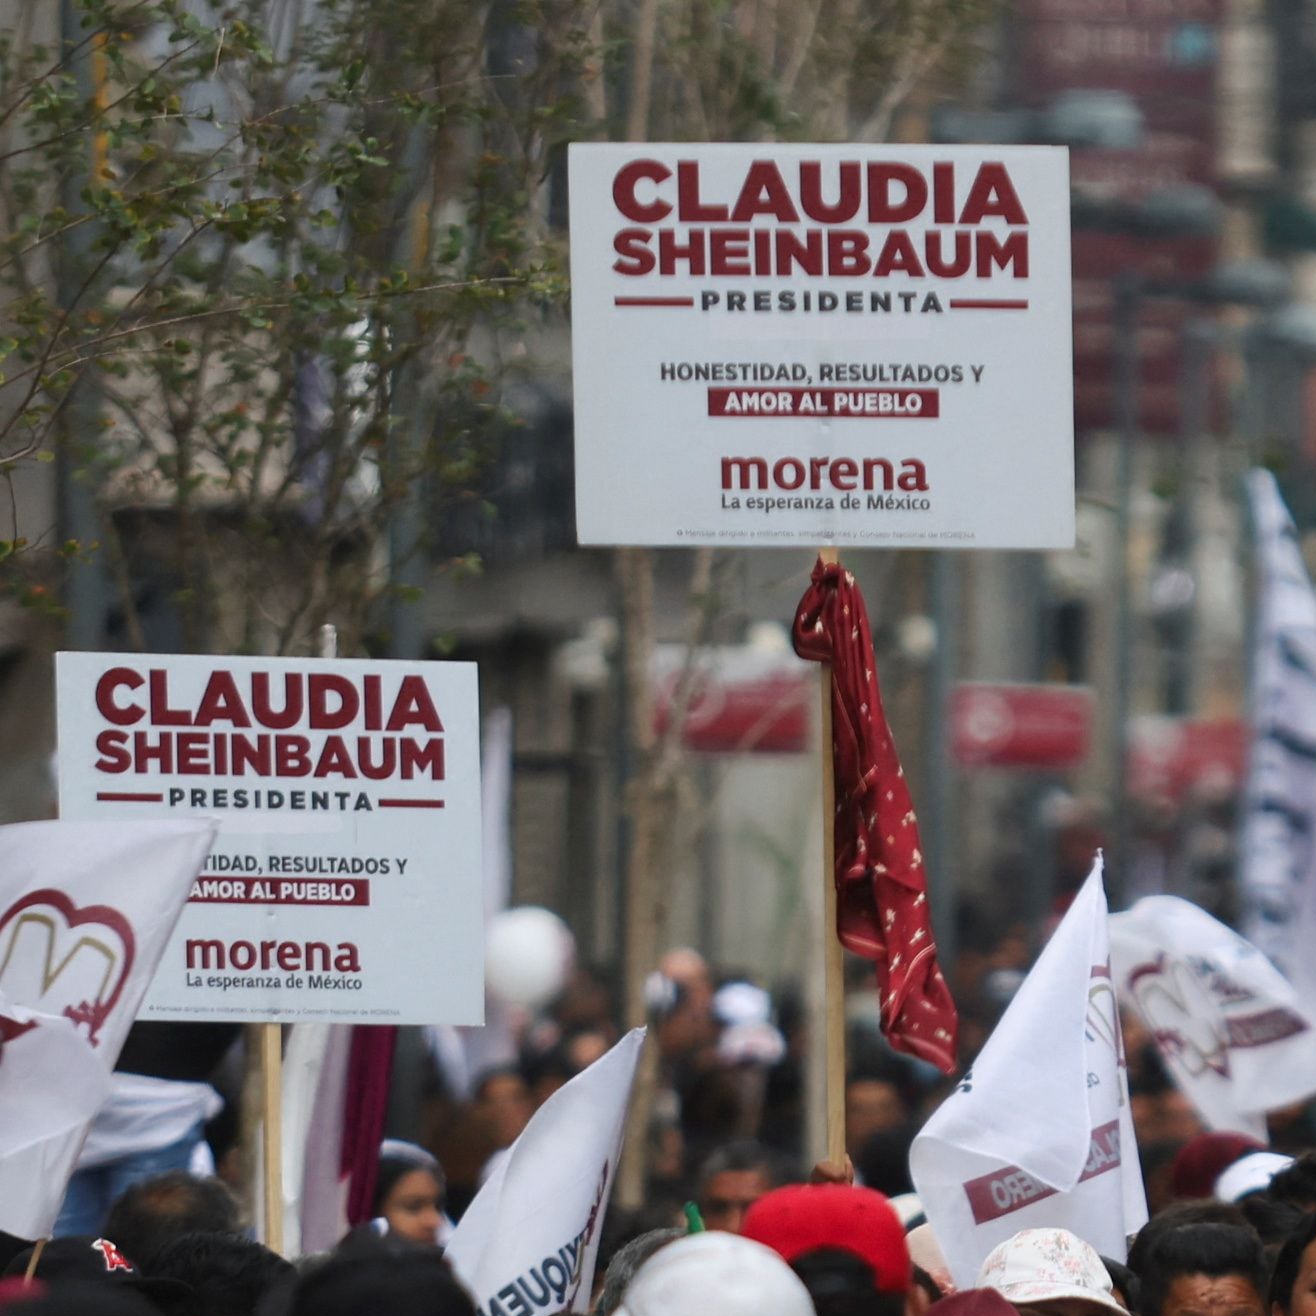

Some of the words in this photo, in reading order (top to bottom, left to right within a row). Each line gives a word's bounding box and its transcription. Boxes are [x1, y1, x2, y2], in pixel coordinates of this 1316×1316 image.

[612, 158, 1029, 225] CLAUDIA
[612, 228, 1029, 279] SHEINBAUM
[701, 289, 944, 313] PRESIDENTA
[660, 361, 813, 385] HONESTIDAD,
[819, 363, 963, 384] RESULTADOS
[971, 364, 985, 383] Y
[724, 392, 794, 413] AMOR
[798, 392, 829, 413] AL
[834, 393, 923, 415] PUEBLO
[720, 454, 930, 491] morena
[721, 493, 741, 510] La
[746, 496, 835, 515] esperanza
[839, 493, 861, 510] de
[867, 492, 931, 511] México
[94, 666, 444, 732] CLAUDIA
[94, 730, 446, 781] SHEINBAUM
[168, 787, 374, 811] PRESIDENTA
[202, 854, 264, 876] TIDAD,
[268, 855, 390, 875] RESULTADOS
[396, 857, 408, 875] Y
[189, 880, 247, 900] AMOR
[249, 882, 275, 900] AL
[280, 882, 356, 902] PUEBLO
[185, 938, 361, 972] morena
[186, 972, 203, 988] La
[207, 974, 282, 993] esperanza
[285, 973, 303, 989] de
[308, 972, 363, 990] México
